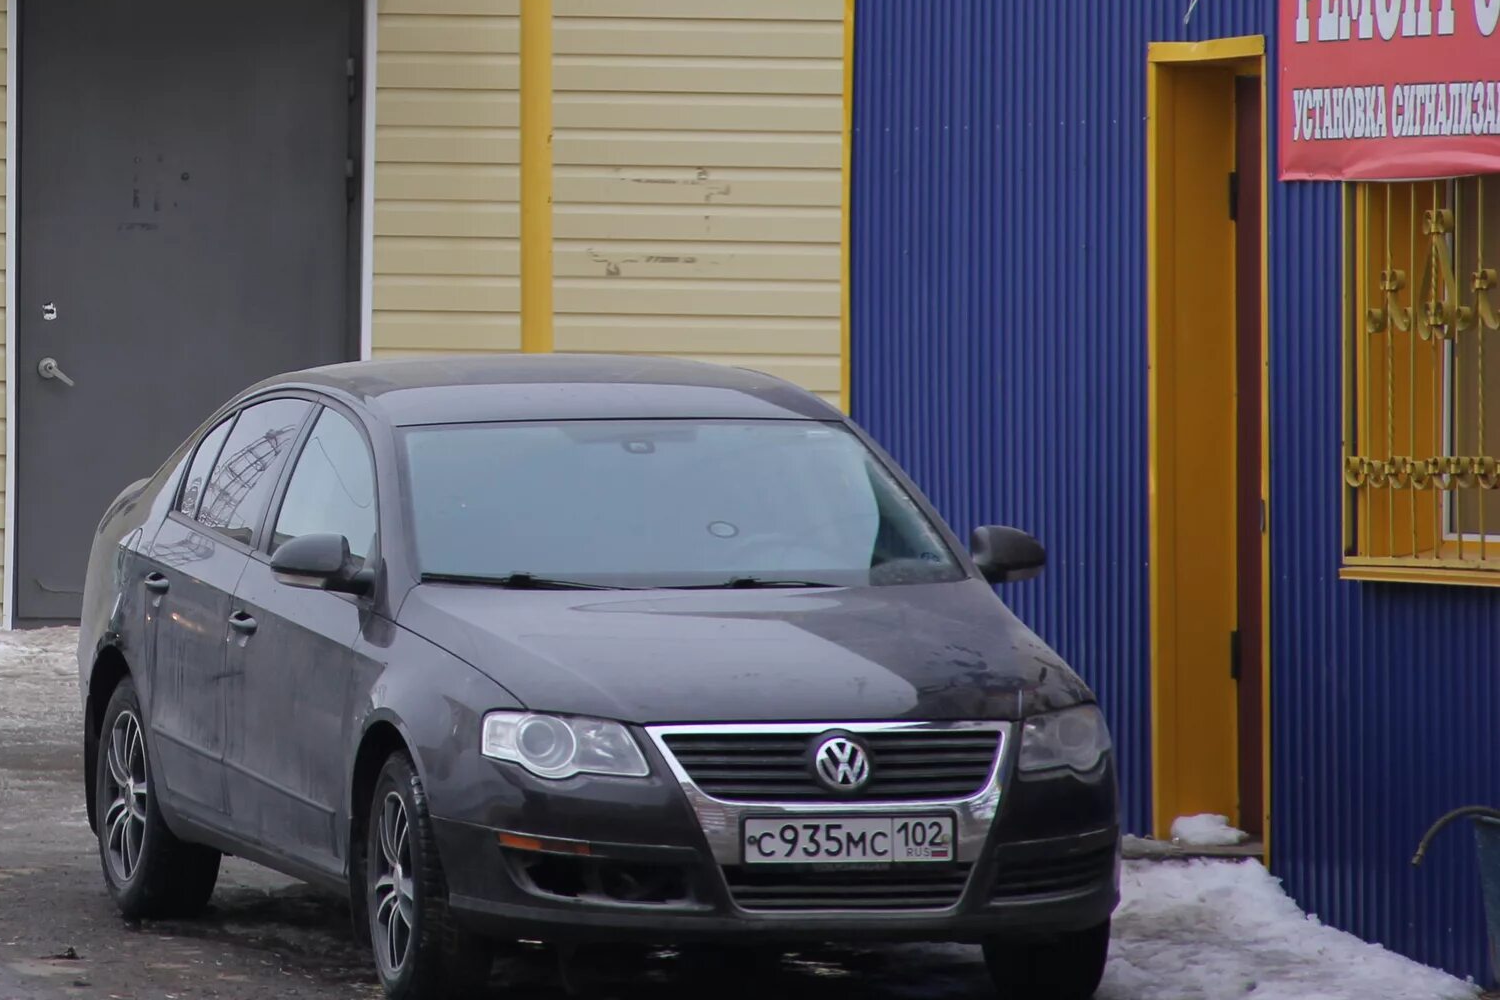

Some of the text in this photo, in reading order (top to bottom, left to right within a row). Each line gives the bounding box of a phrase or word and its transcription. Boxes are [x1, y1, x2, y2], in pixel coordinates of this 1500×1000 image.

[1292, 80, 1500, 141] УСТАНОВКА СИГНАЛИЗА
[756, 821, 943, 858] С935МС 102
[906, 847, 931, 858] RUS
